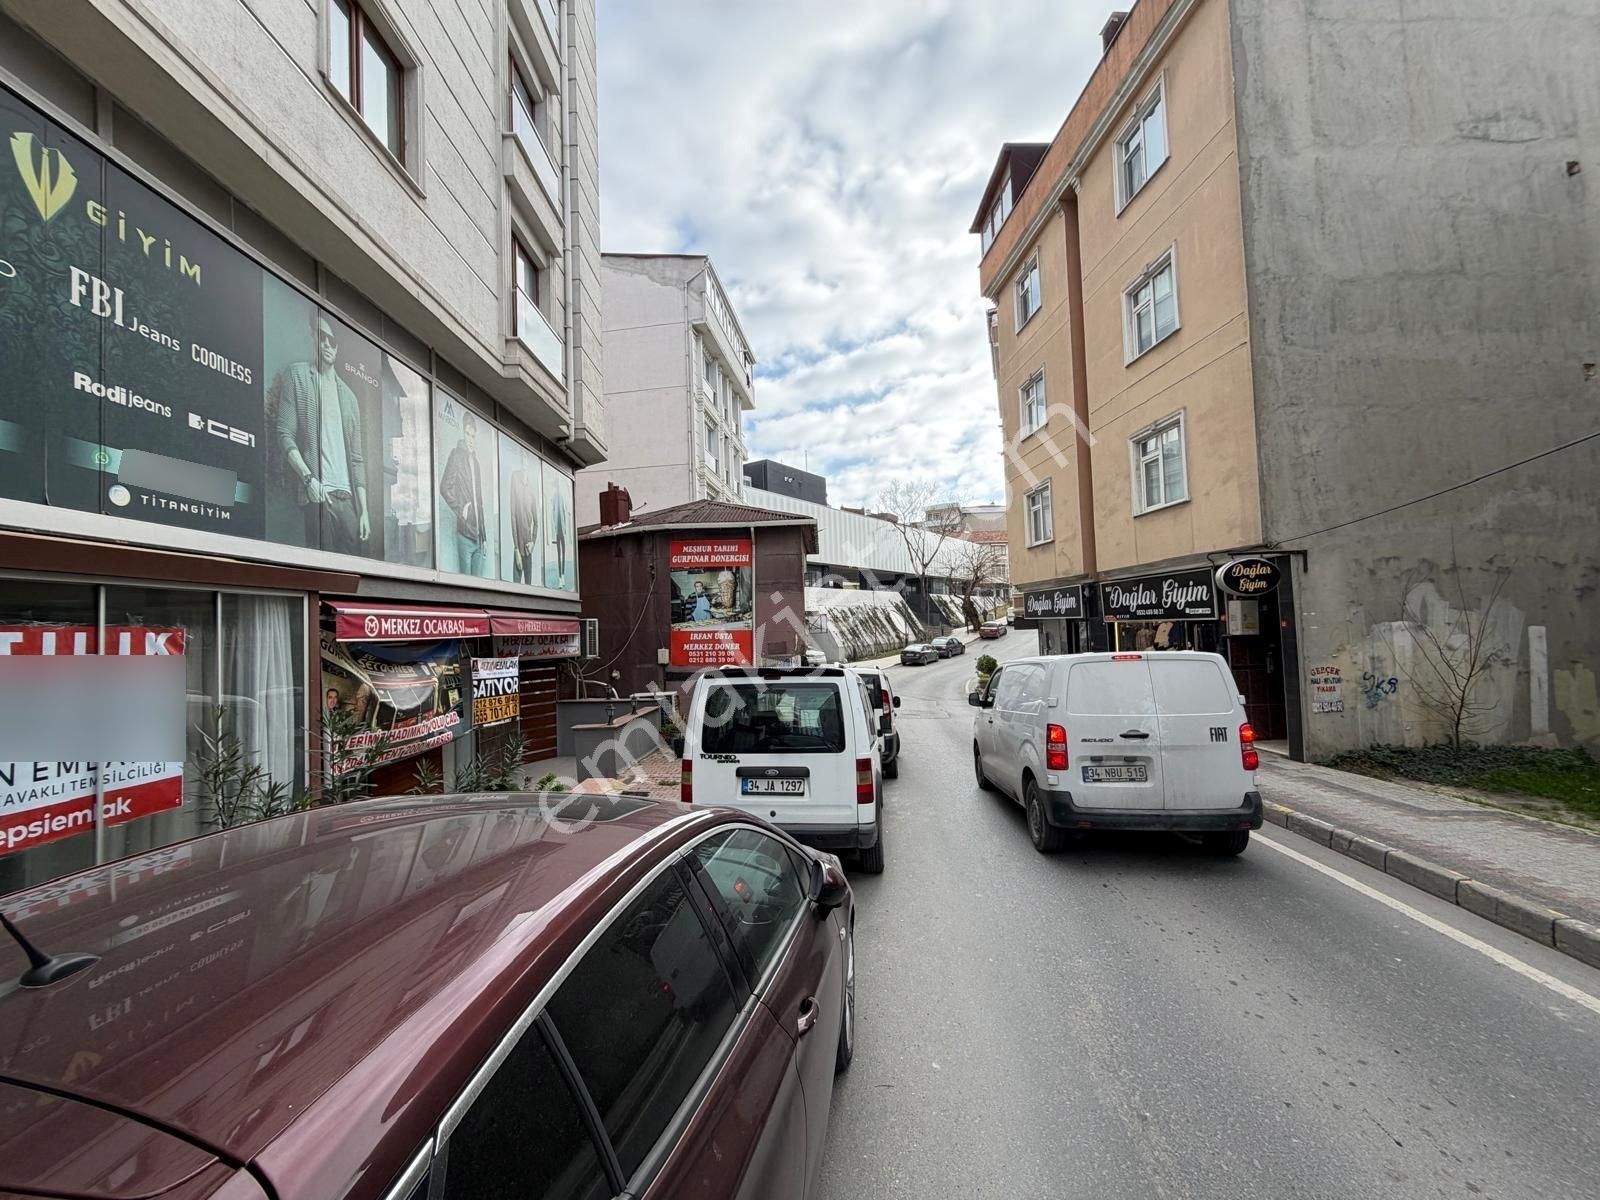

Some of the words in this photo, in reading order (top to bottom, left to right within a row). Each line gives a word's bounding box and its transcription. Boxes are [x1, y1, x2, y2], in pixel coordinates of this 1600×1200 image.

[69, 266, 125, 327] FBI
[128, 317, 181, 351] Jeans
[345, 362, 379, 388] BRANGO
[1110, 583, 1157, 612] Dağlar
[1162, 579, 1209, 610] Giyim
[381, 618, 421, 635] MERKEZ
[472, 677, 519, 698] SATIYOR
[1210, 727, 1227, 742] FIAT
[1088, 768, 1100, 778] 34
[1104, 768, 1122, 778] NBU
[1127, 767, 1145, 778] 515
[0, 782, 65, 809] AVAKLI
[748, 780, 760, 792] 34
[764, 780, 776, 792] JA
[780, 780, 803, 792] 1297
